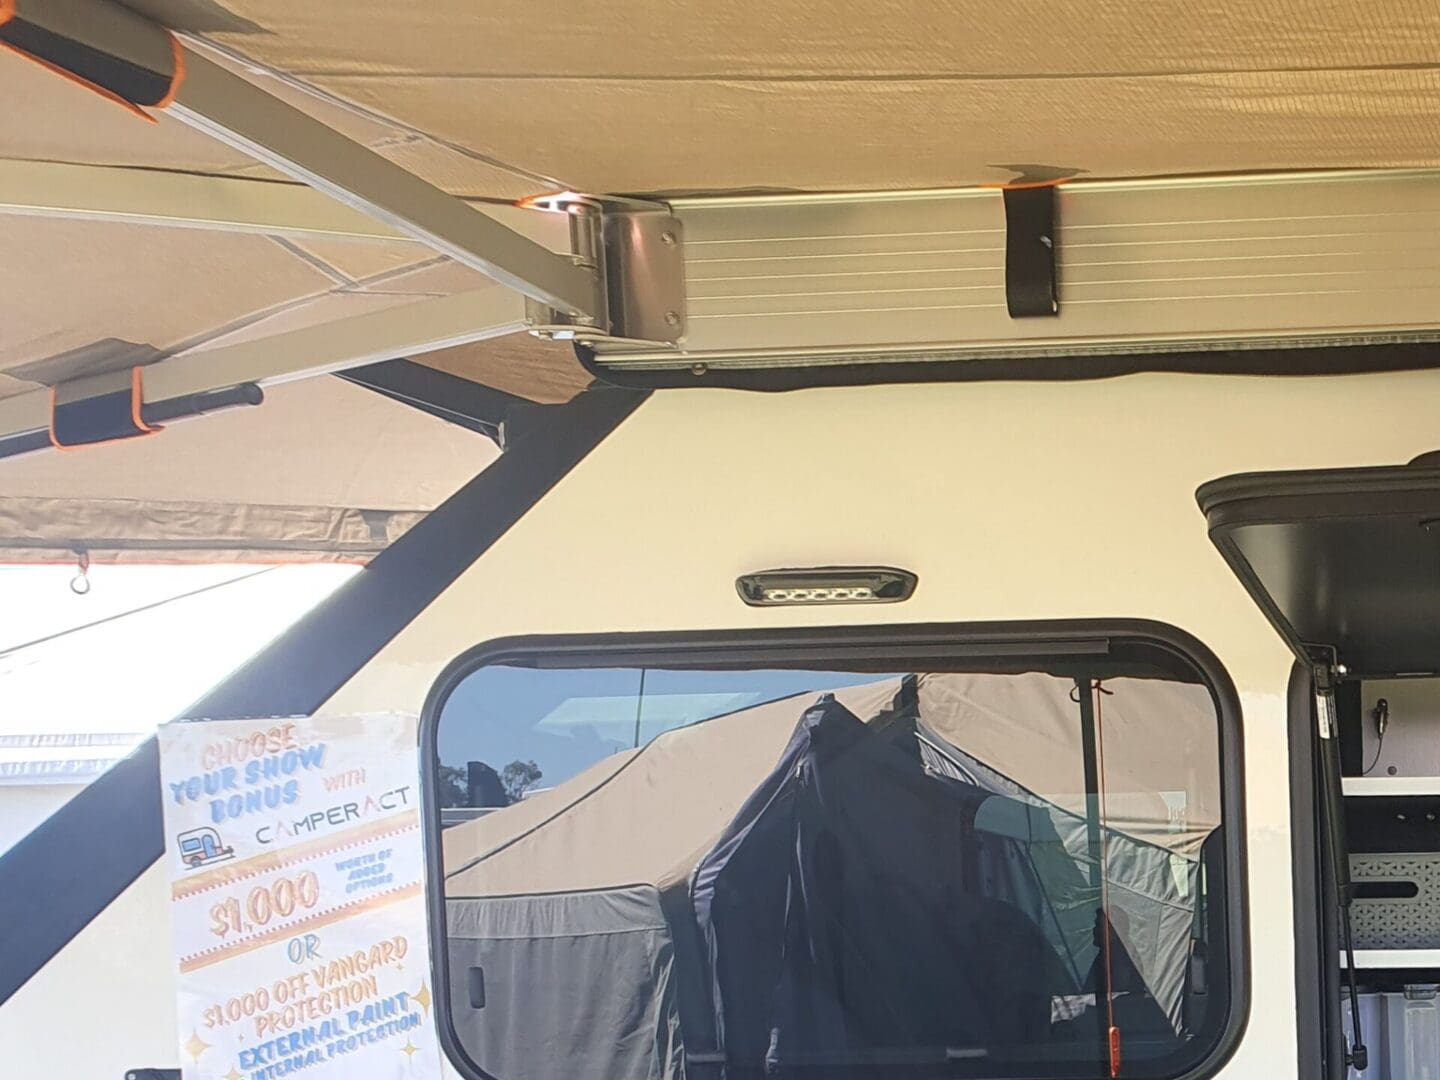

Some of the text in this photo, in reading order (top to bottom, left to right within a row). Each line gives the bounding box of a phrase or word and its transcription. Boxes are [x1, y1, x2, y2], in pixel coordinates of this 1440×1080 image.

[170, 742, 327, 805] YOUR SHOW
[202, 723, 297, 770] CHOOSE
[208, 779, 299, 824] BONUS
[323, 768, 366, 792] WITH
[255, 786, 411, 845] CAMPERACT
[209, 869, 320, 939] $1,000
[287, 933, 322, 964] OR
[203, 935, 408, 1030] $1,000 OFF VANGARD
[255, 975, 378, 1038] PROTECTION
[238, 991, 412, 1071] EXTERNAL PAINT
[327, 1011, 422, 1058] PROTECTION
